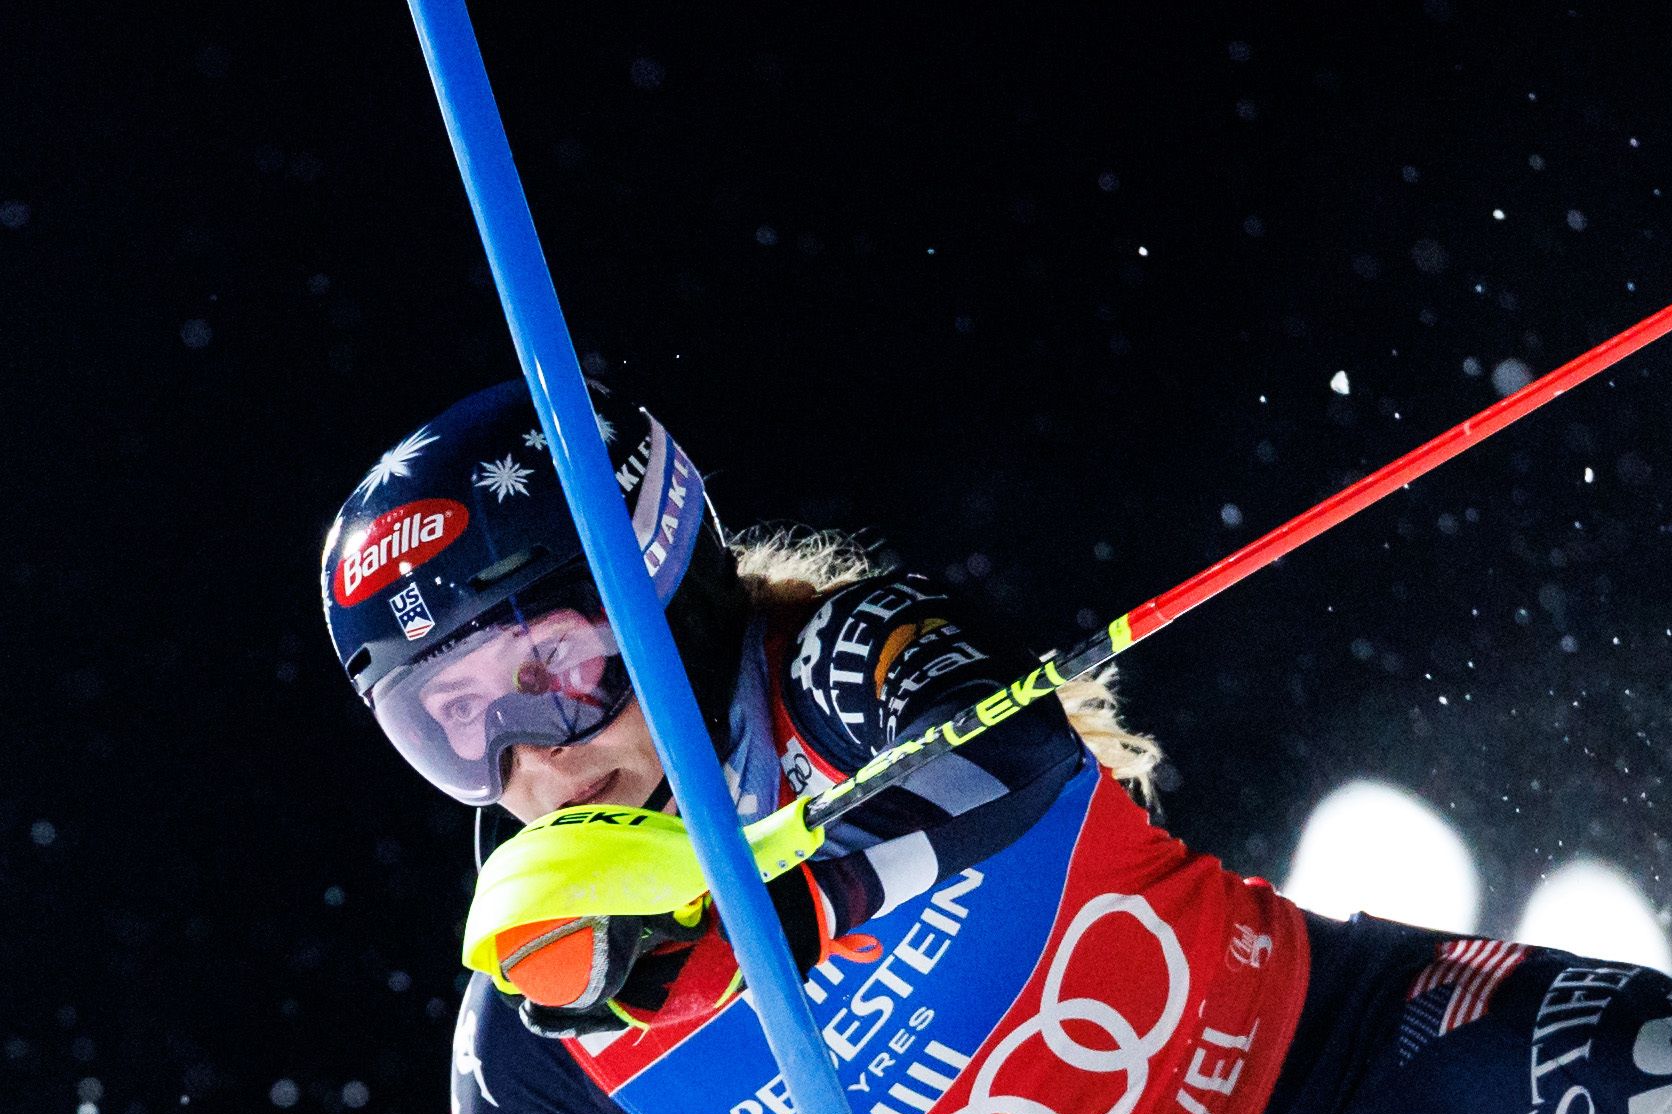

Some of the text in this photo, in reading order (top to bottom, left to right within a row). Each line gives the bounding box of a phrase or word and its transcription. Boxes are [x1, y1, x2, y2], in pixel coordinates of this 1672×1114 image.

[343, 511, 445, 597] Barilla
[390, 587, 421, 614] US
[941, 660, 1068, 747] LEKI
[848, 1006, 936, 1093] YRES
